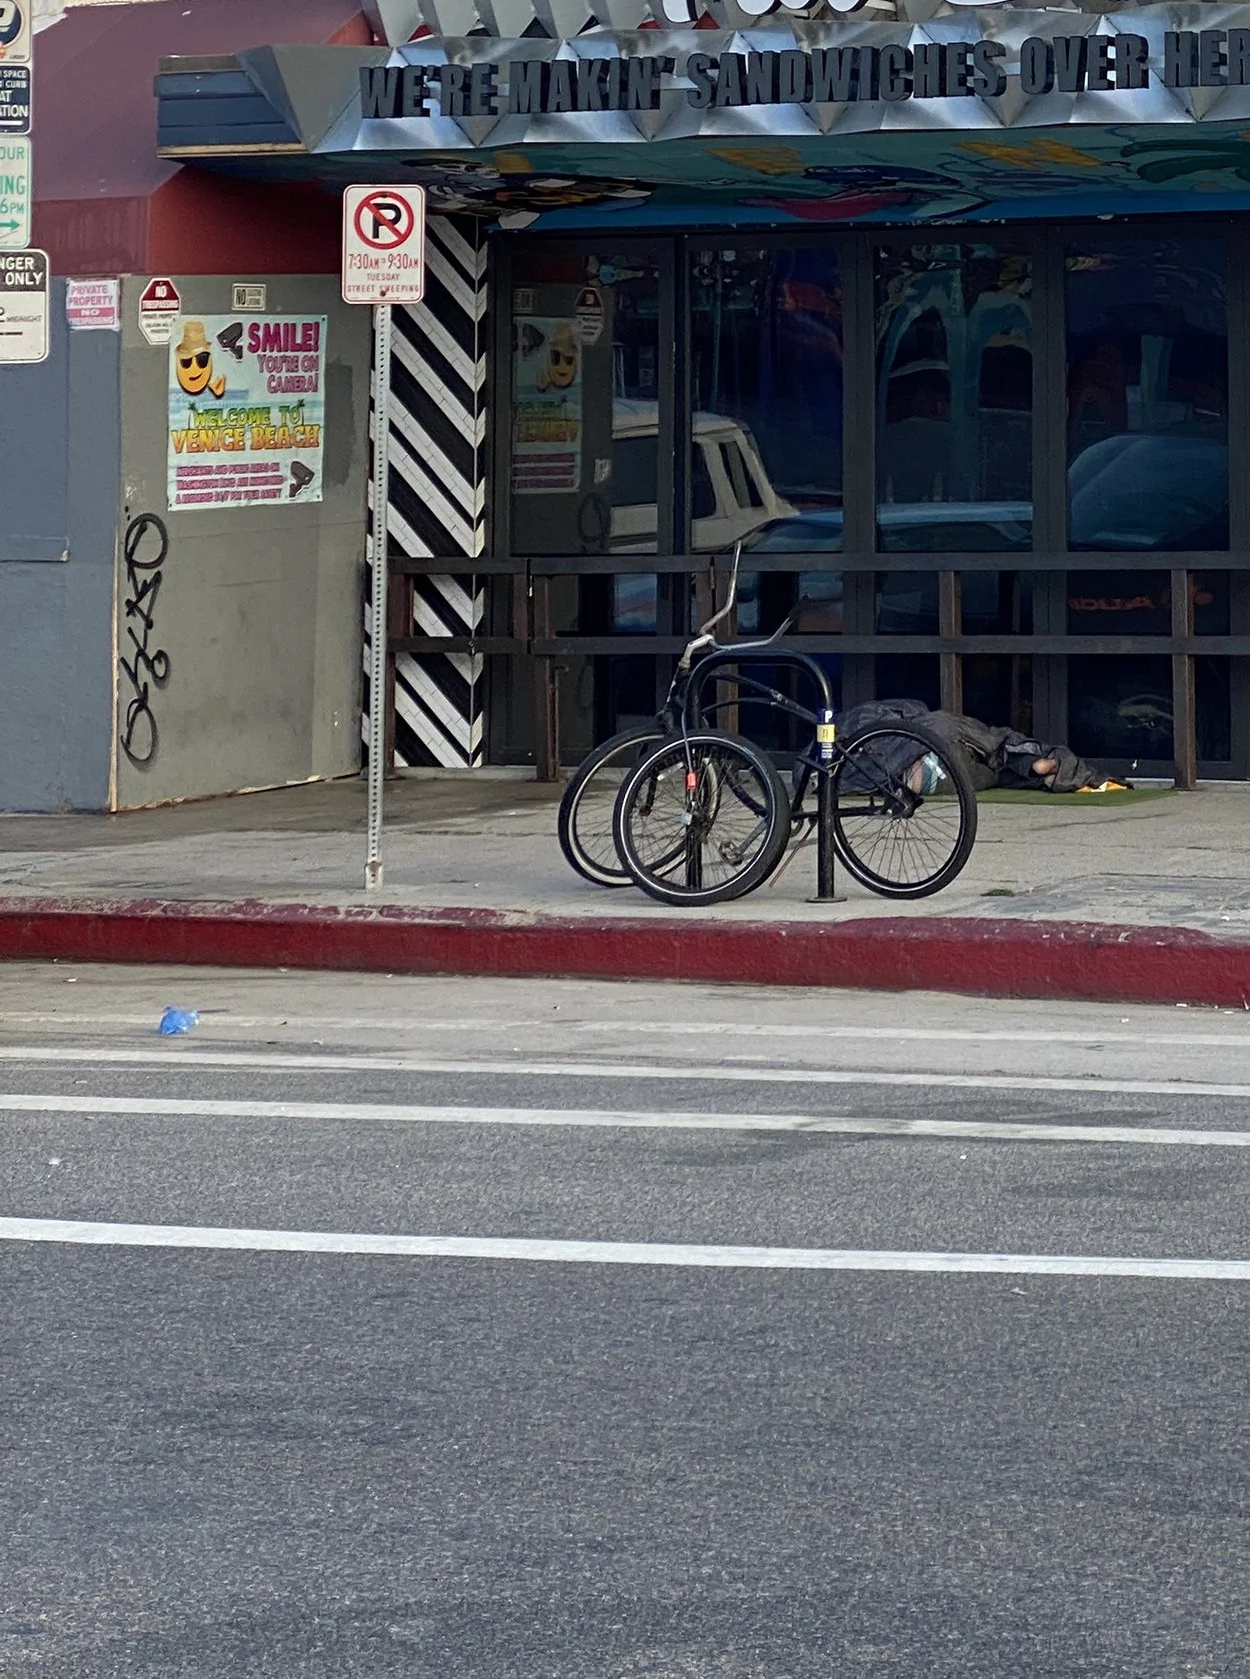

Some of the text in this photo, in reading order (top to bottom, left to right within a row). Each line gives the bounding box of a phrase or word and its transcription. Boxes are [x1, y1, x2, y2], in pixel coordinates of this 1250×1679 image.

[3, 69, 27, 79] SPACE
[359, 63, 499, 118] WE'RE
[509, 55, 675, 114] MAKIN'
[687, 39, 1007, 110] SANDWICHES
[1020, 33, 1149, 95] OVER
[5, 80, 27, 89] CURB
[0, 104, 28, 118] TION
[348, 253, 380, 270] 7:30AM
[387, 253, 419, 270] 9:30AM
[5, 271, 44, 286] ONLY
[367, 272, 401, 281] TUESDAY
[71, 284, 108, 295] PRIVATE
[155, 285, 168, 298] NO
[347, 284, 375, 293] STREET
[67, 295, 113, 307] PROPERTY
[6, 314, 42, 322] MIDNIGHT
[80, 307, 100, 316] NO
[247, 321, 321, 354] SMILE!
[258, 354, 319, 373] YOU'RE ON
[193, 404, 302, 429] WELCOME TO
[171, 423, 320, 454] VENICE BEACH
